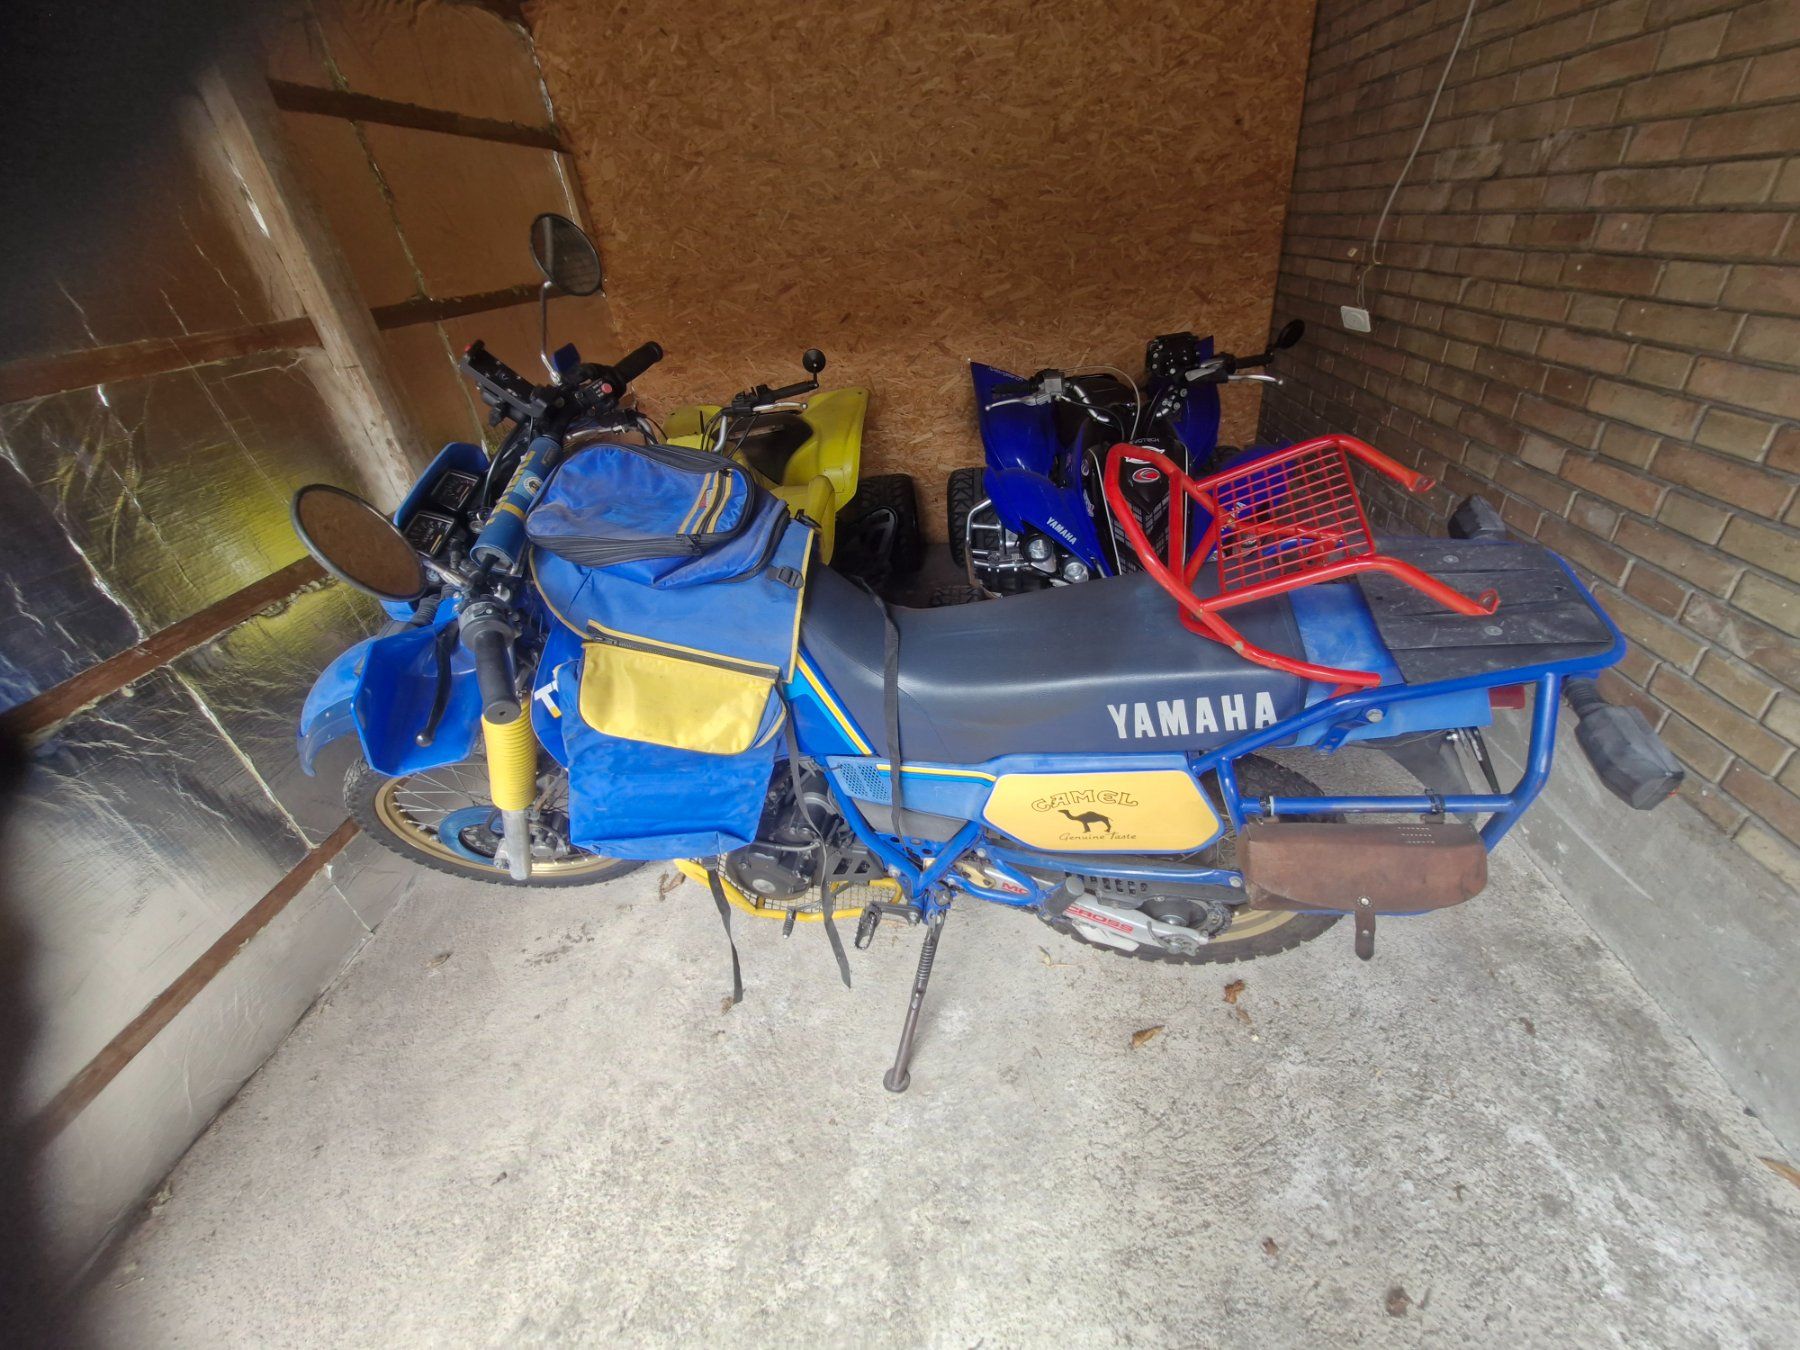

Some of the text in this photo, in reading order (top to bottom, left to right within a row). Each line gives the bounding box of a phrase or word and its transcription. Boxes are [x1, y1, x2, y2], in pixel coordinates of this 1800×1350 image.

[1046, 516, 1077, 545] YAMAHA
[1107, 691, 1278, 739] YAMAHA
[1031, 789, 1139, 812] CAMEL
[1058, 831, 1137, 841] Genuine Taste
